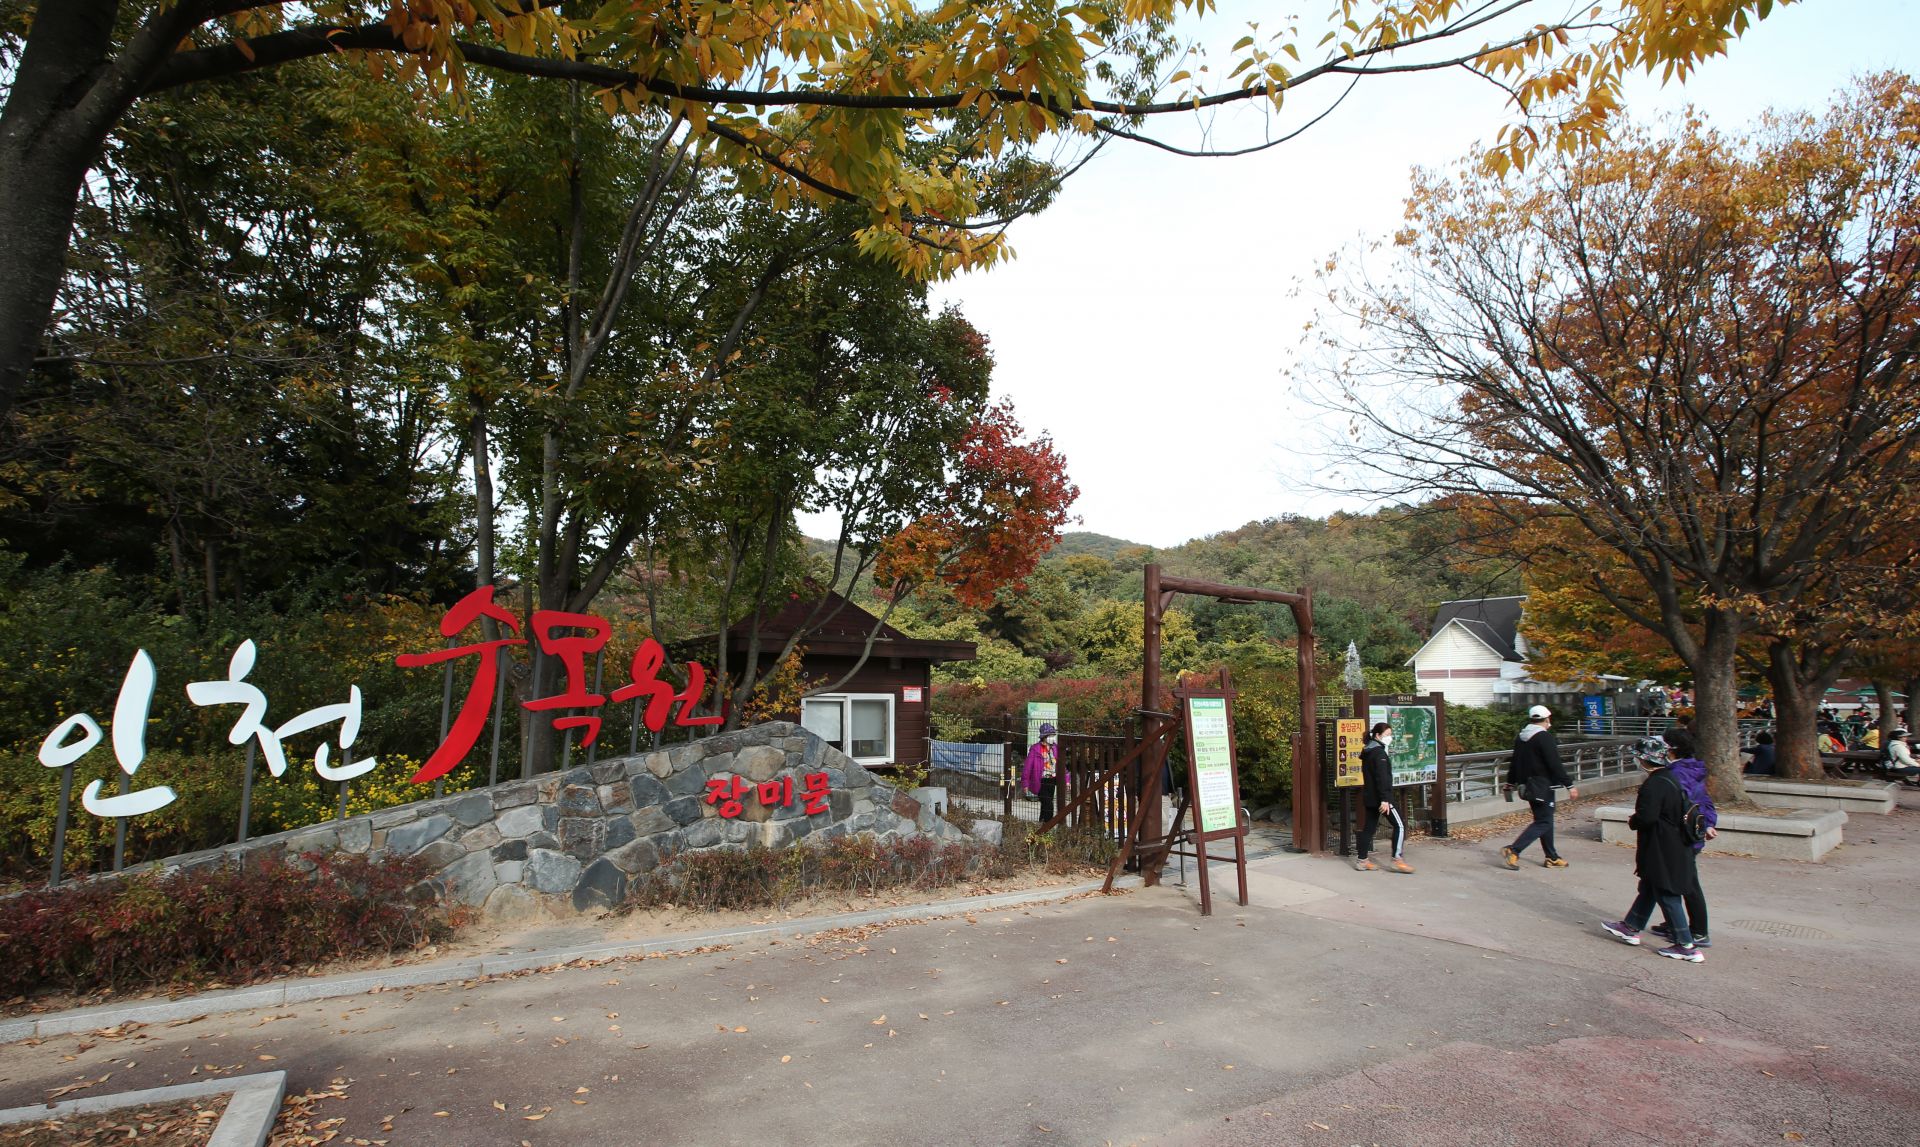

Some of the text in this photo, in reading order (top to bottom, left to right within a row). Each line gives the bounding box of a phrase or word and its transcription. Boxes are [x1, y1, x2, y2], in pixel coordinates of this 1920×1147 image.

[37, 584, 725, 818] 인천 수목원
[1340, 722, 1362, 733] 출입금지
[704, 771, 833, 820] 장미문
